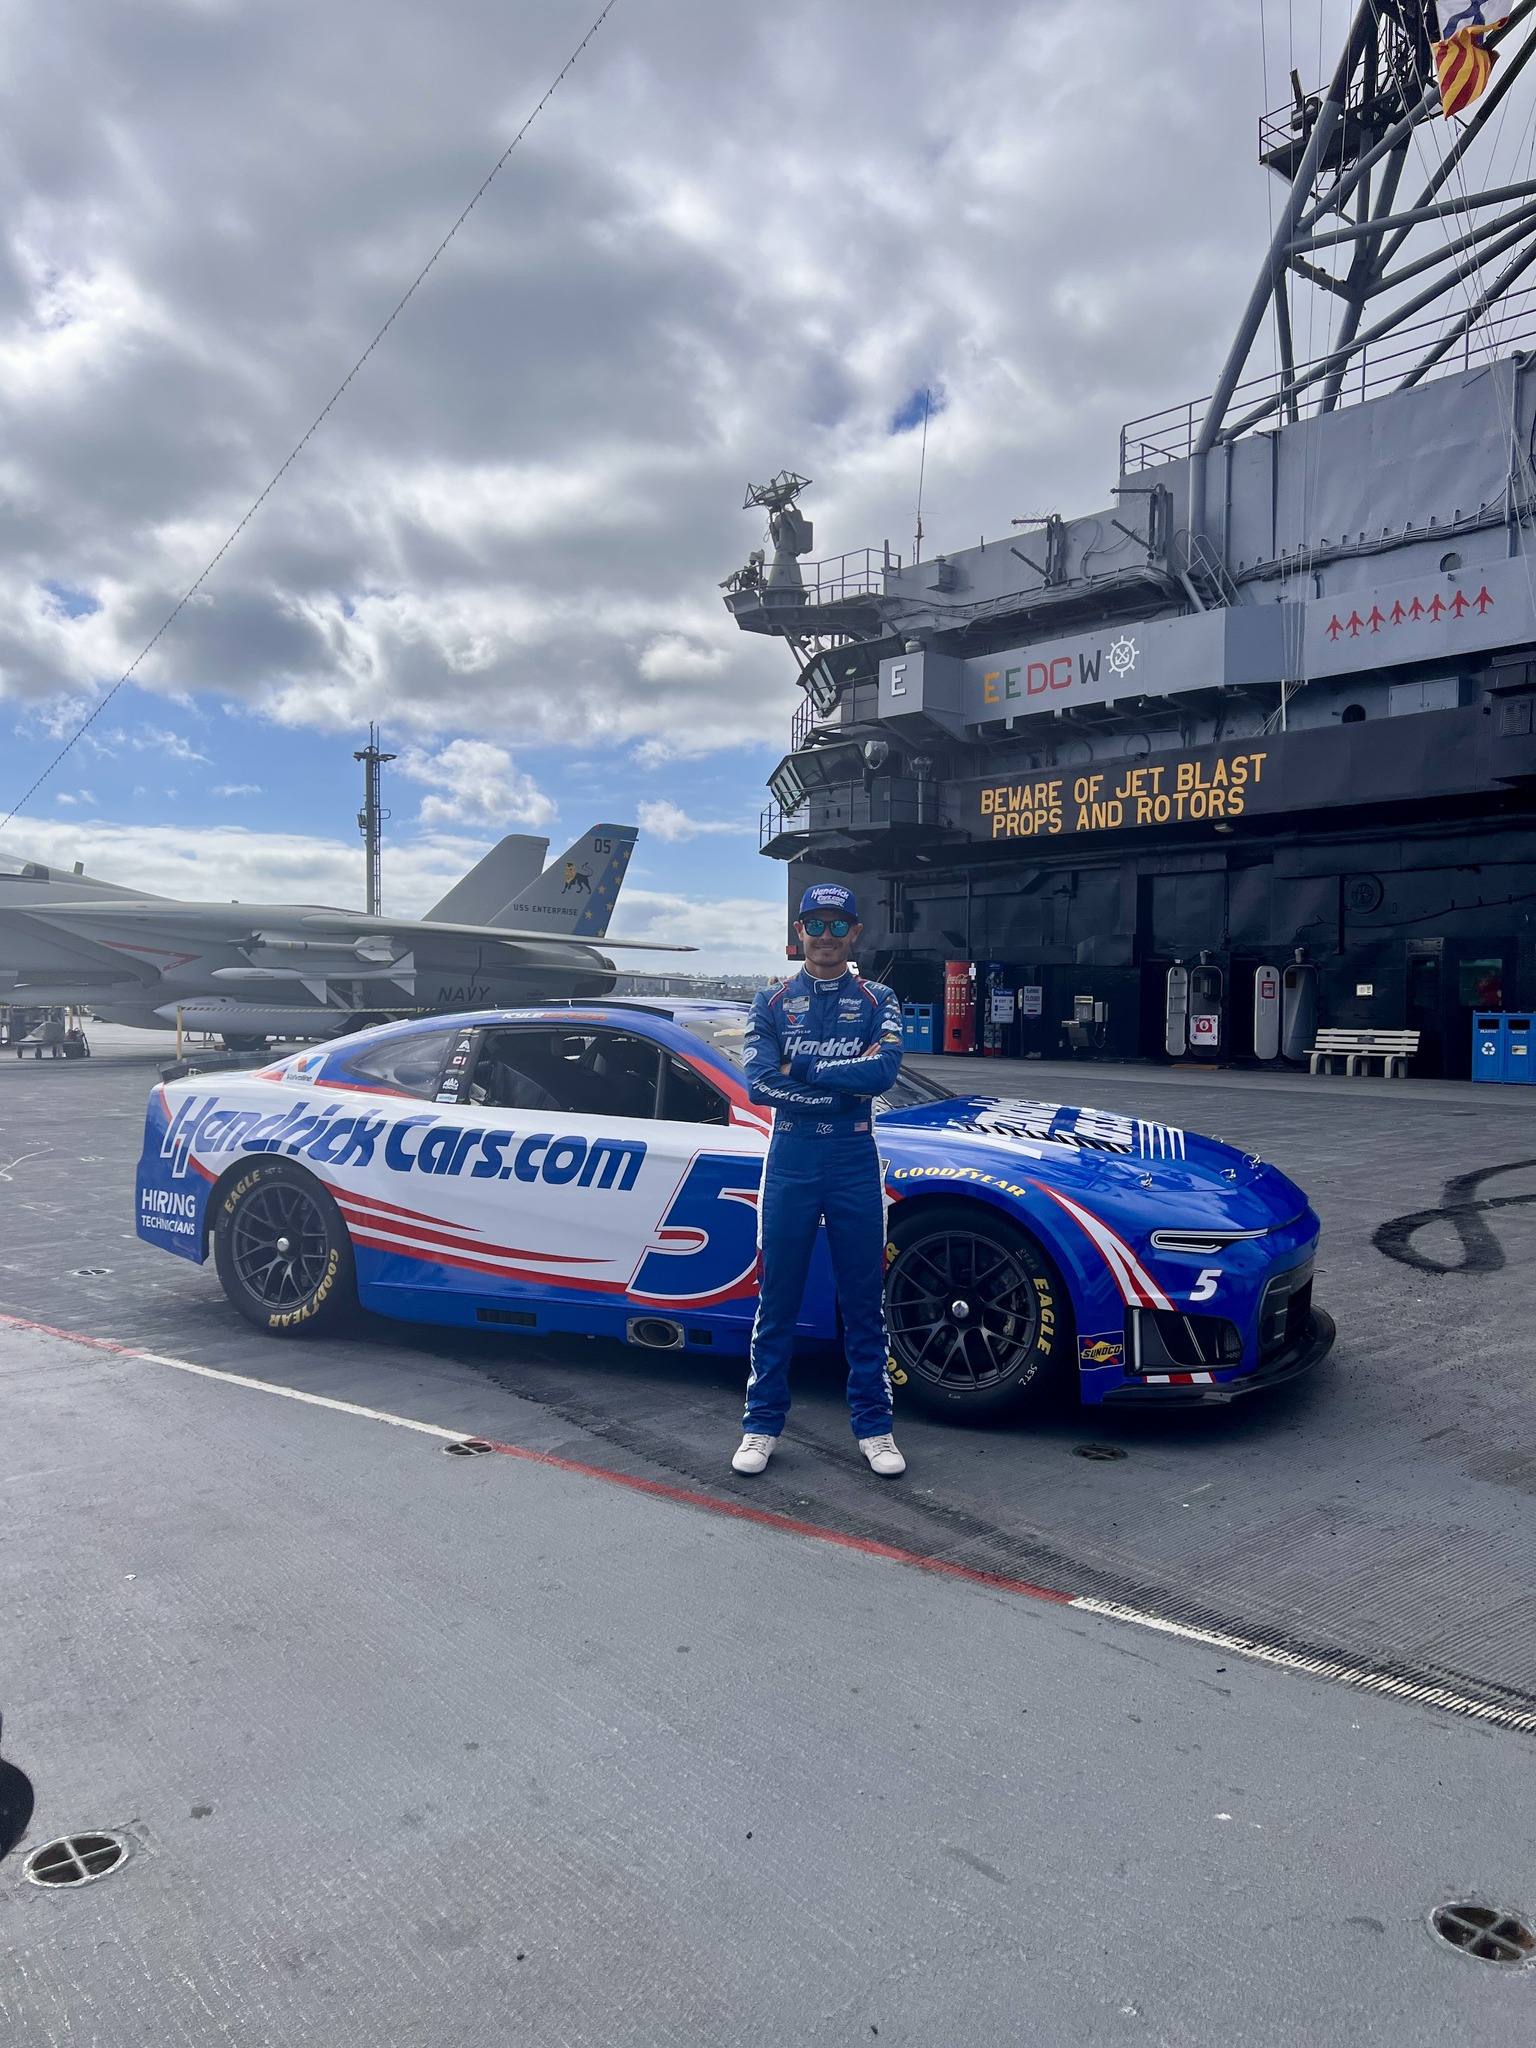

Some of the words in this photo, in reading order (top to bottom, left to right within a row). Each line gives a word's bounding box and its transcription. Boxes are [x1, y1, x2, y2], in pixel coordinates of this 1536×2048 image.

[891, 664, 906, 696] E
[981, 780, 1062, 815] BEWARE
[1074, 775, 1104, 803] OF
[1115, 766, 1165, 799] JET
[1176, 753, 1267, 792] BLAST
[992, 810, 1062, 838] PROPS
[1076, 800, 1123, 832] AND
[1136, 787, 1245, 824] ROTORS
[594, 838, 612, 854] 05
[811, 888, 850, 900] Hendrick
[513, 904, 530, 913] USS
[532, 905, 579, 916] ENTERPRISE
[438, 986, 490, 1002] NAVY
[784, 1036, 864, 1060] Hendrick
[224, 1169, 261, 1214] EAGLE
[894, 1167, 1026, 1198] GOODYEAR
[141, 1188, 196, 1218] HIRING
[141, 1215, 195, 1236] TECHNICIANS
[625, 1148, 765, 1300] 5
[268, 1248, 339, 1328] GOODYEAR
[1189, 1269, 1223, 1301] 5
[1032, 1278, 1055, 1356] EAGLE
[1082, 1344, 1122, 1359] SUNOCO
